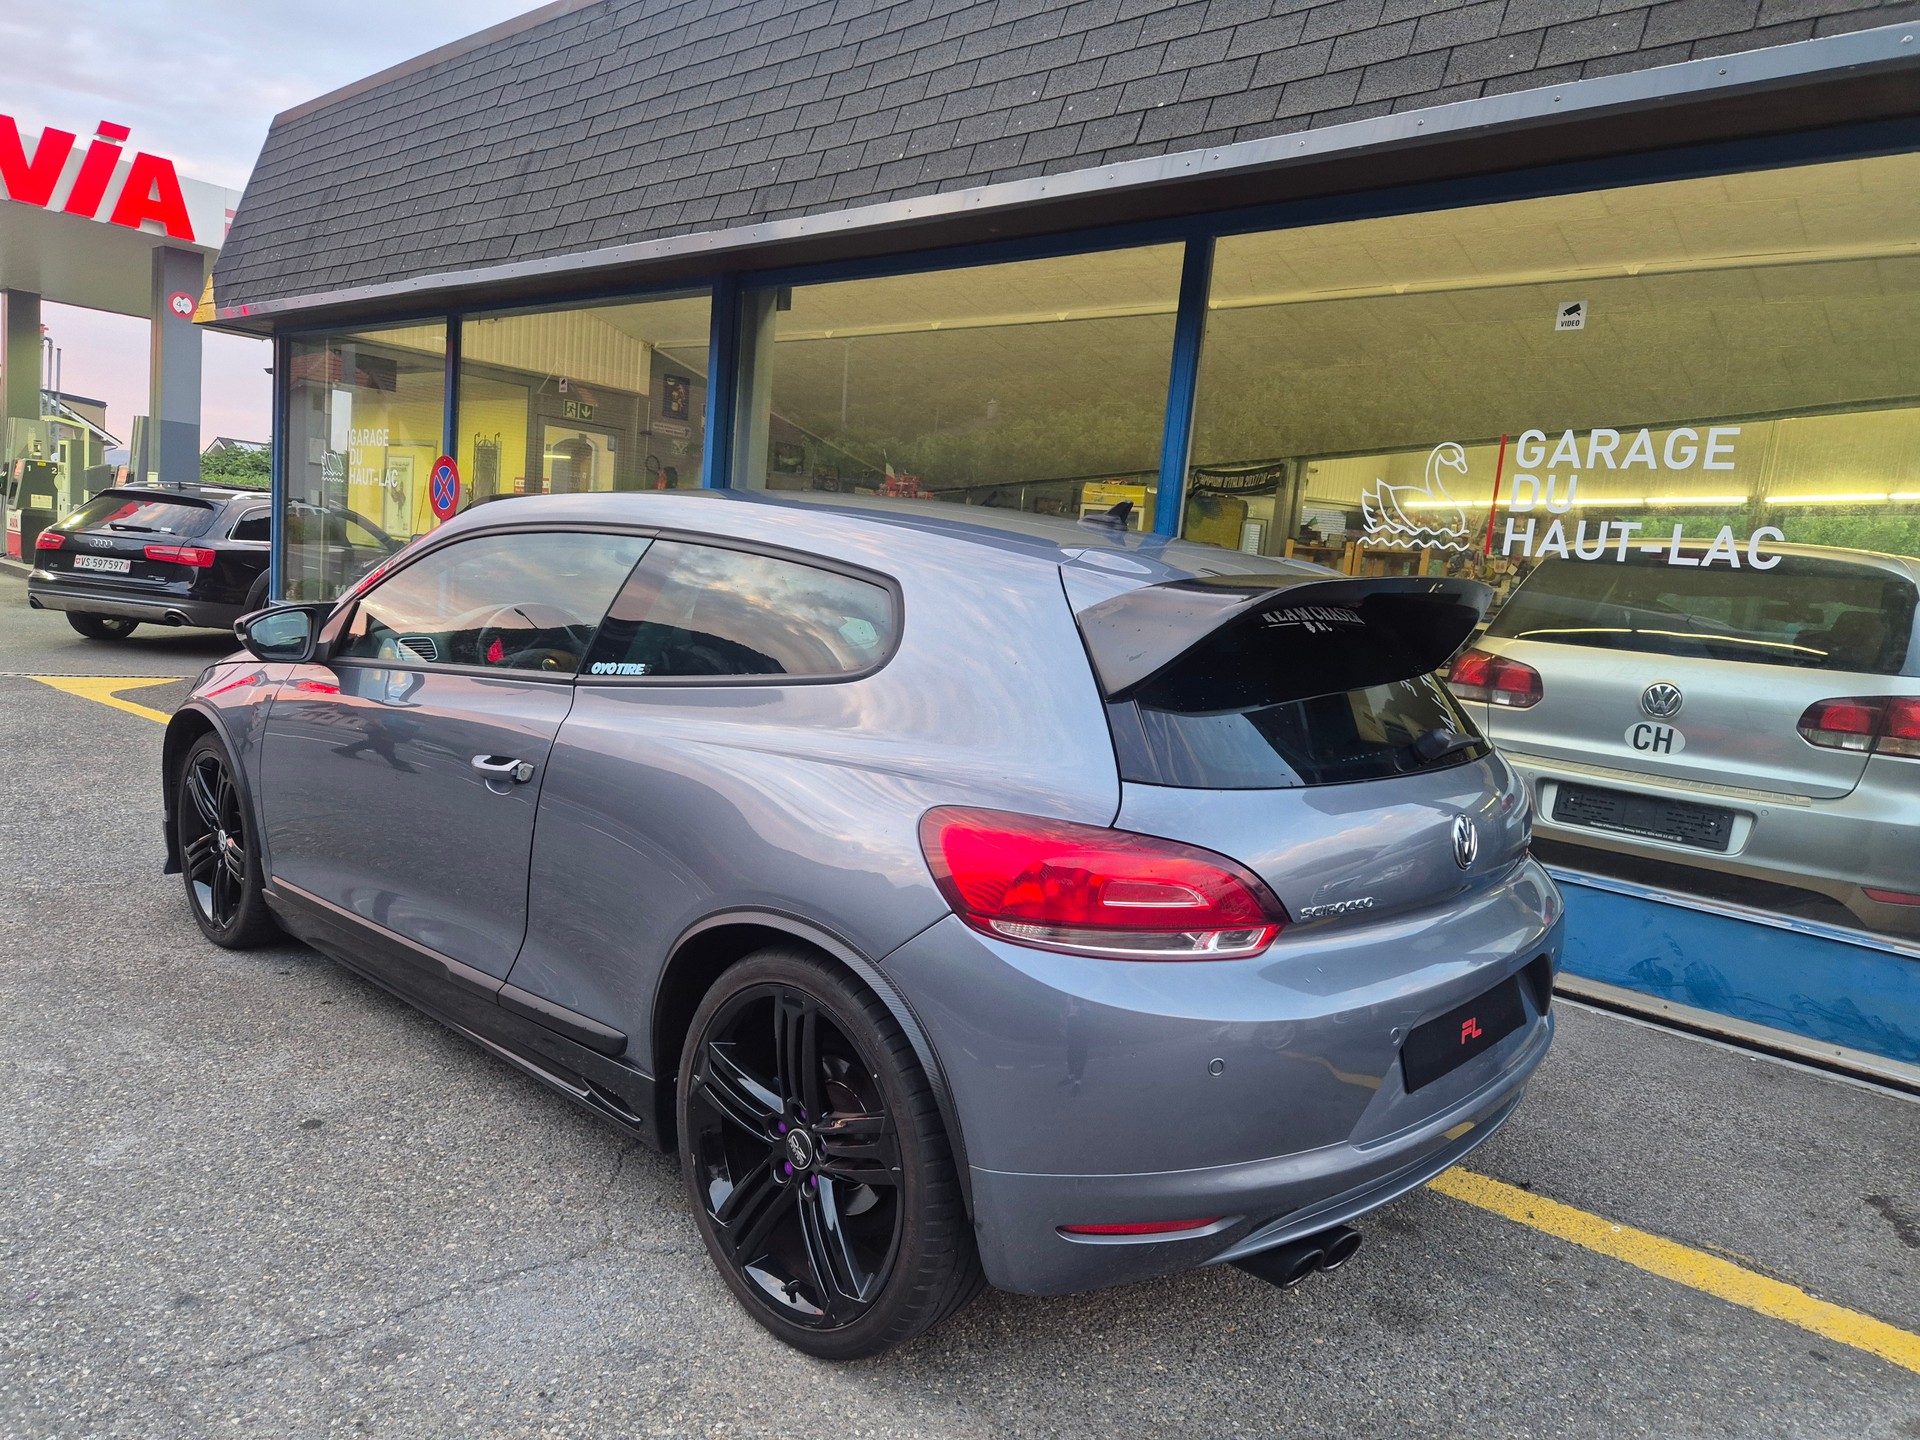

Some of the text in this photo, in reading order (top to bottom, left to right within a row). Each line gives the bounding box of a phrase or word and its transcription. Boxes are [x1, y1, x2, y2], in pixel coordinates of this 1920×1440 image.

[350, 429, 389, 446] GARAGE
[1515, 427, 1741, 470] GARAGE
[349, 448, 363, 465] DU
[349, 467, 398, 487] HAUT-LAC
[1508, 474, 1578, 513] DU
[1502, 517, 1785, 570] HAUT-LAC
[1633, 724, 1674, 754] CH
[1301, 897, 1374, 920] SCIROCCO
[1461, 1017, 1482, 1045] FL
